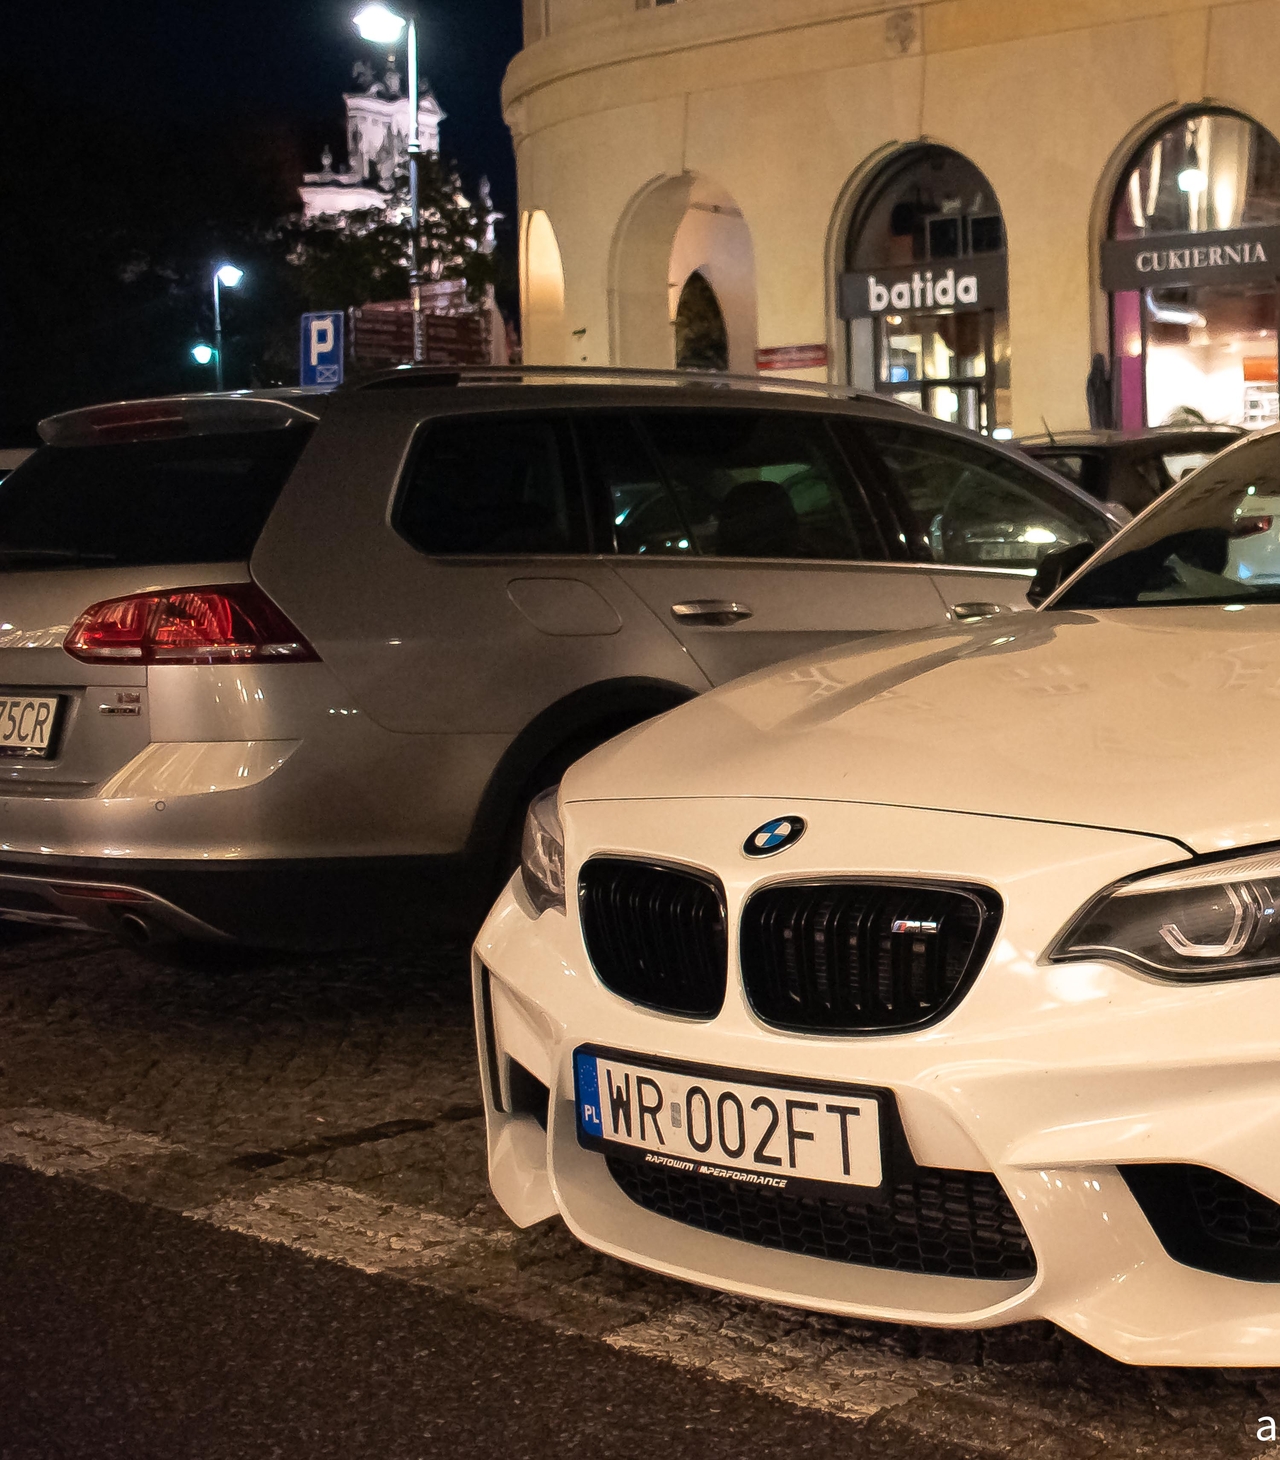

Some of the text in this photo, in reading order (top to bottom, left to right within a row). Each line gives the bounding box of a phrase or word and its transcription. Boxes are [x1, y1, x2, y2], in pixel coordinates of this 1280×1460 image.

[1134, 242, 1268, 272] CUKIERNIA
[867, 268, 978, 312] batida
[311, 319, 334, 366] P
[584, 1105, 599, 1123] PL
[605, 1068, 861, 1176] WR 002FT
